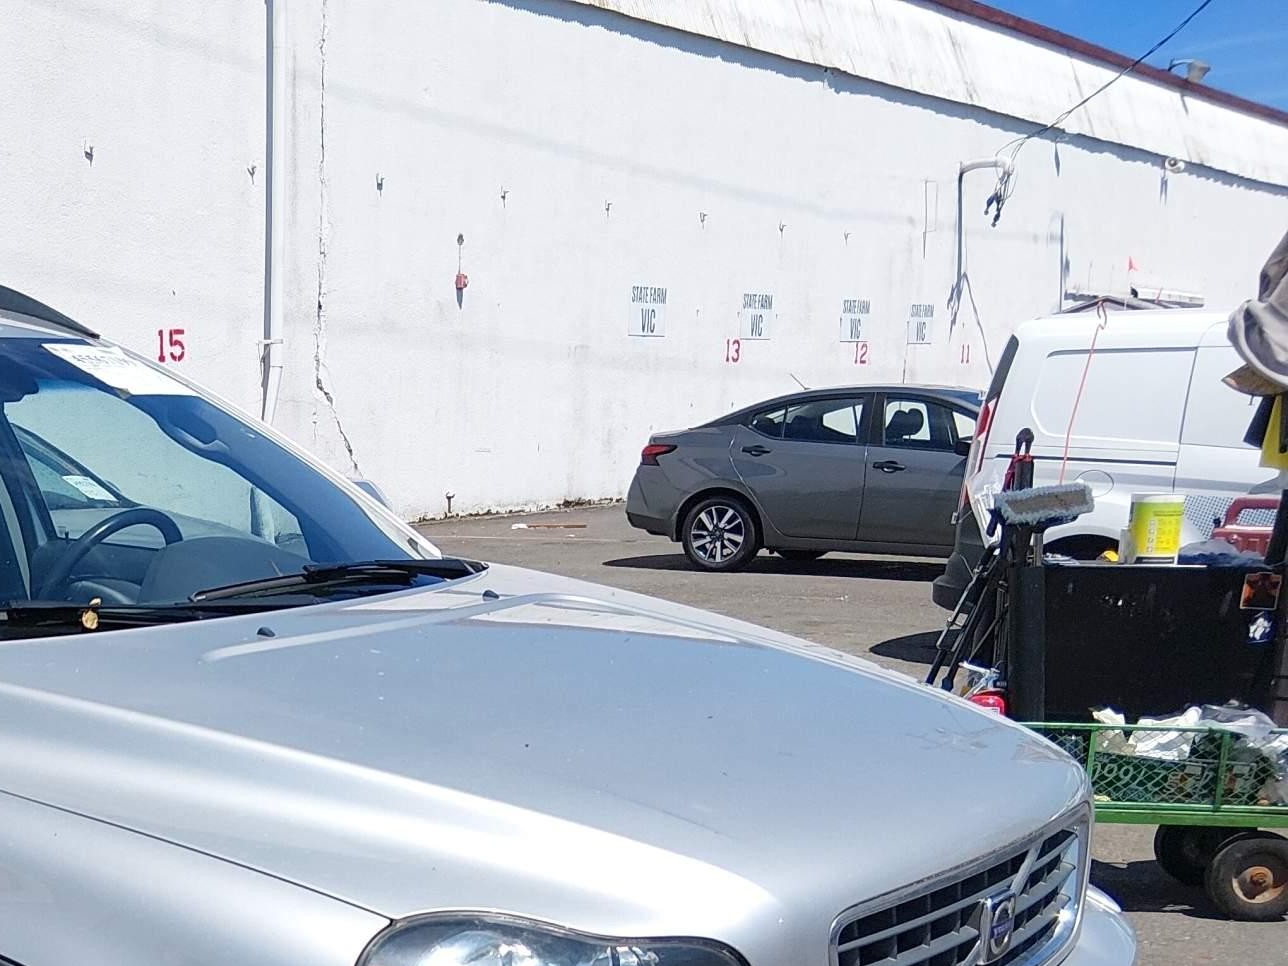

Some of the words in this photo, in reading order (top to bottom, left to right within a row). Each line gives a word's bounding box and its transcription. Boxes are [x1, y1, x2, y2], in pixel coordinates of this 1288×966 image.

[632, 285, 649, 304] STATE
[650, 287, 667, 305] FARM
[743, 293, 757, 310] STATE
[758, 294, 773, 310] FARM
[641, 308, 656, 333] VIC
[750, 314, 763, 337] VIC
[850, 318, 861, 339] VIC
[158, 328, 185, 363] 15
[725, 338, 741, 363] 13
[854, 342, 868, 364] 12
[961, 343, 970, 364] 11
